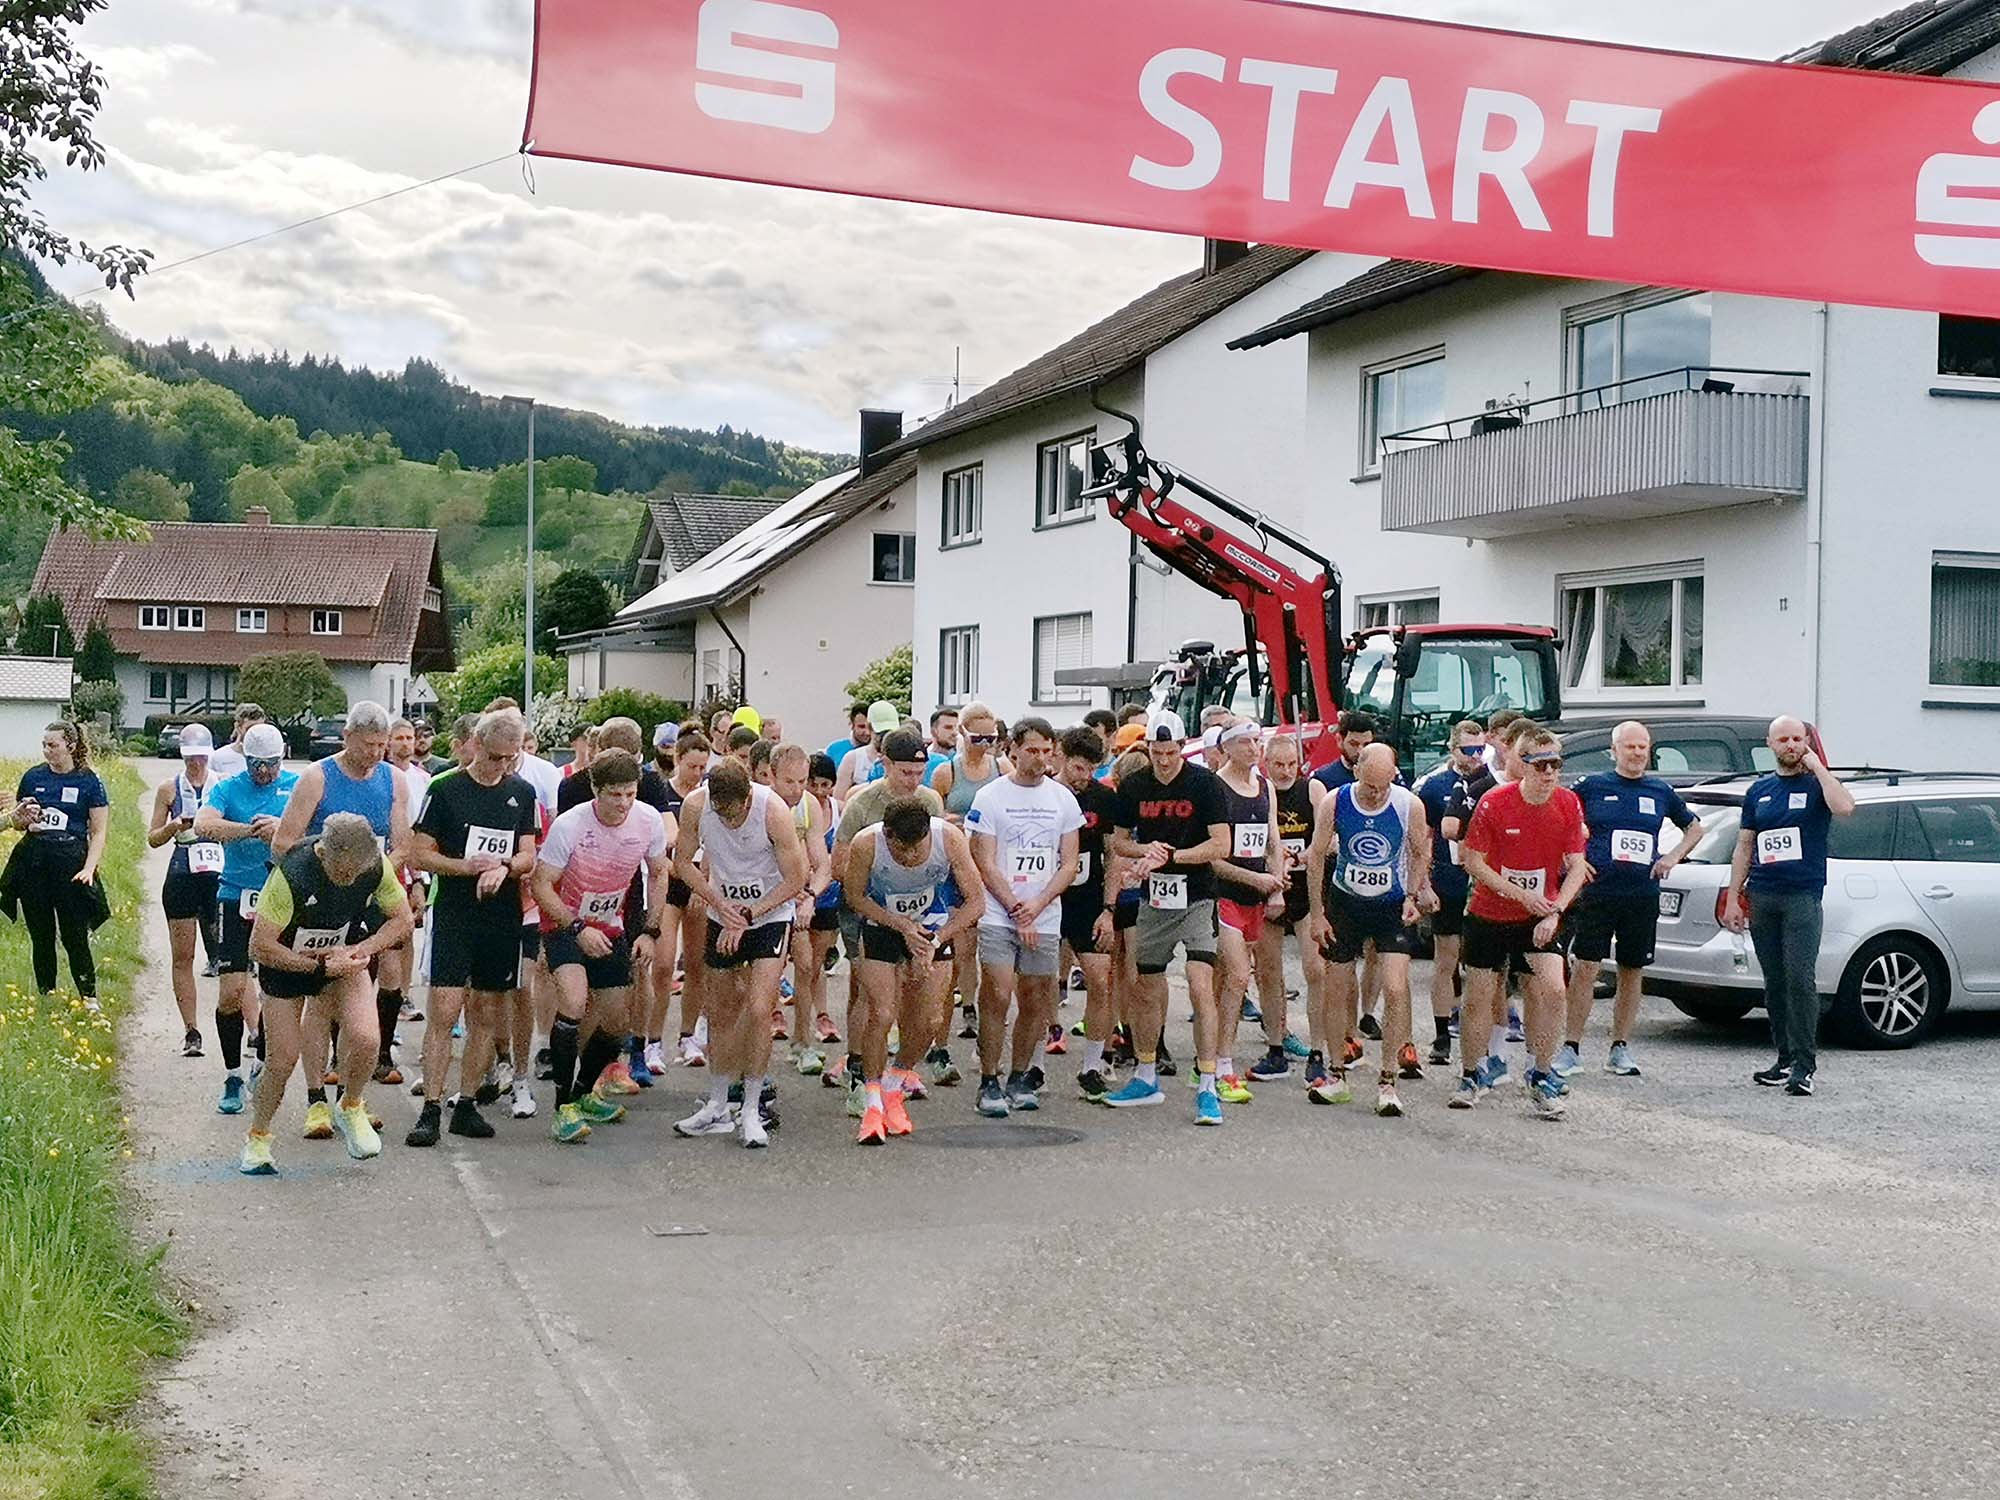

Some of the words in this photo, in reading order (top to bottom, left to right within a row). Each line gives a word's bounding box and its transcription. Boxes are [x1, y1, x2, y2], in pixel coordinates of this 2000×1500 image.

[1129, 48, 1662, 238] START
[1139, 800, 1193, 818] WTO
[477, 835, 508, 854] 769
[1242, 832, 1264, 847] 376
[1620, 837, 1646, 853] 655
[1764, 835, 1791, 851] 659
[1015, 855, 1045, 871] 770
[1348, 869, 1387, 886] 1288
[721, 884, 761, 900] 1286
[1152, 880, 1178, 897] 734
[589, 897, 618, 913] 644
[896, 894, 927, 912] 640
